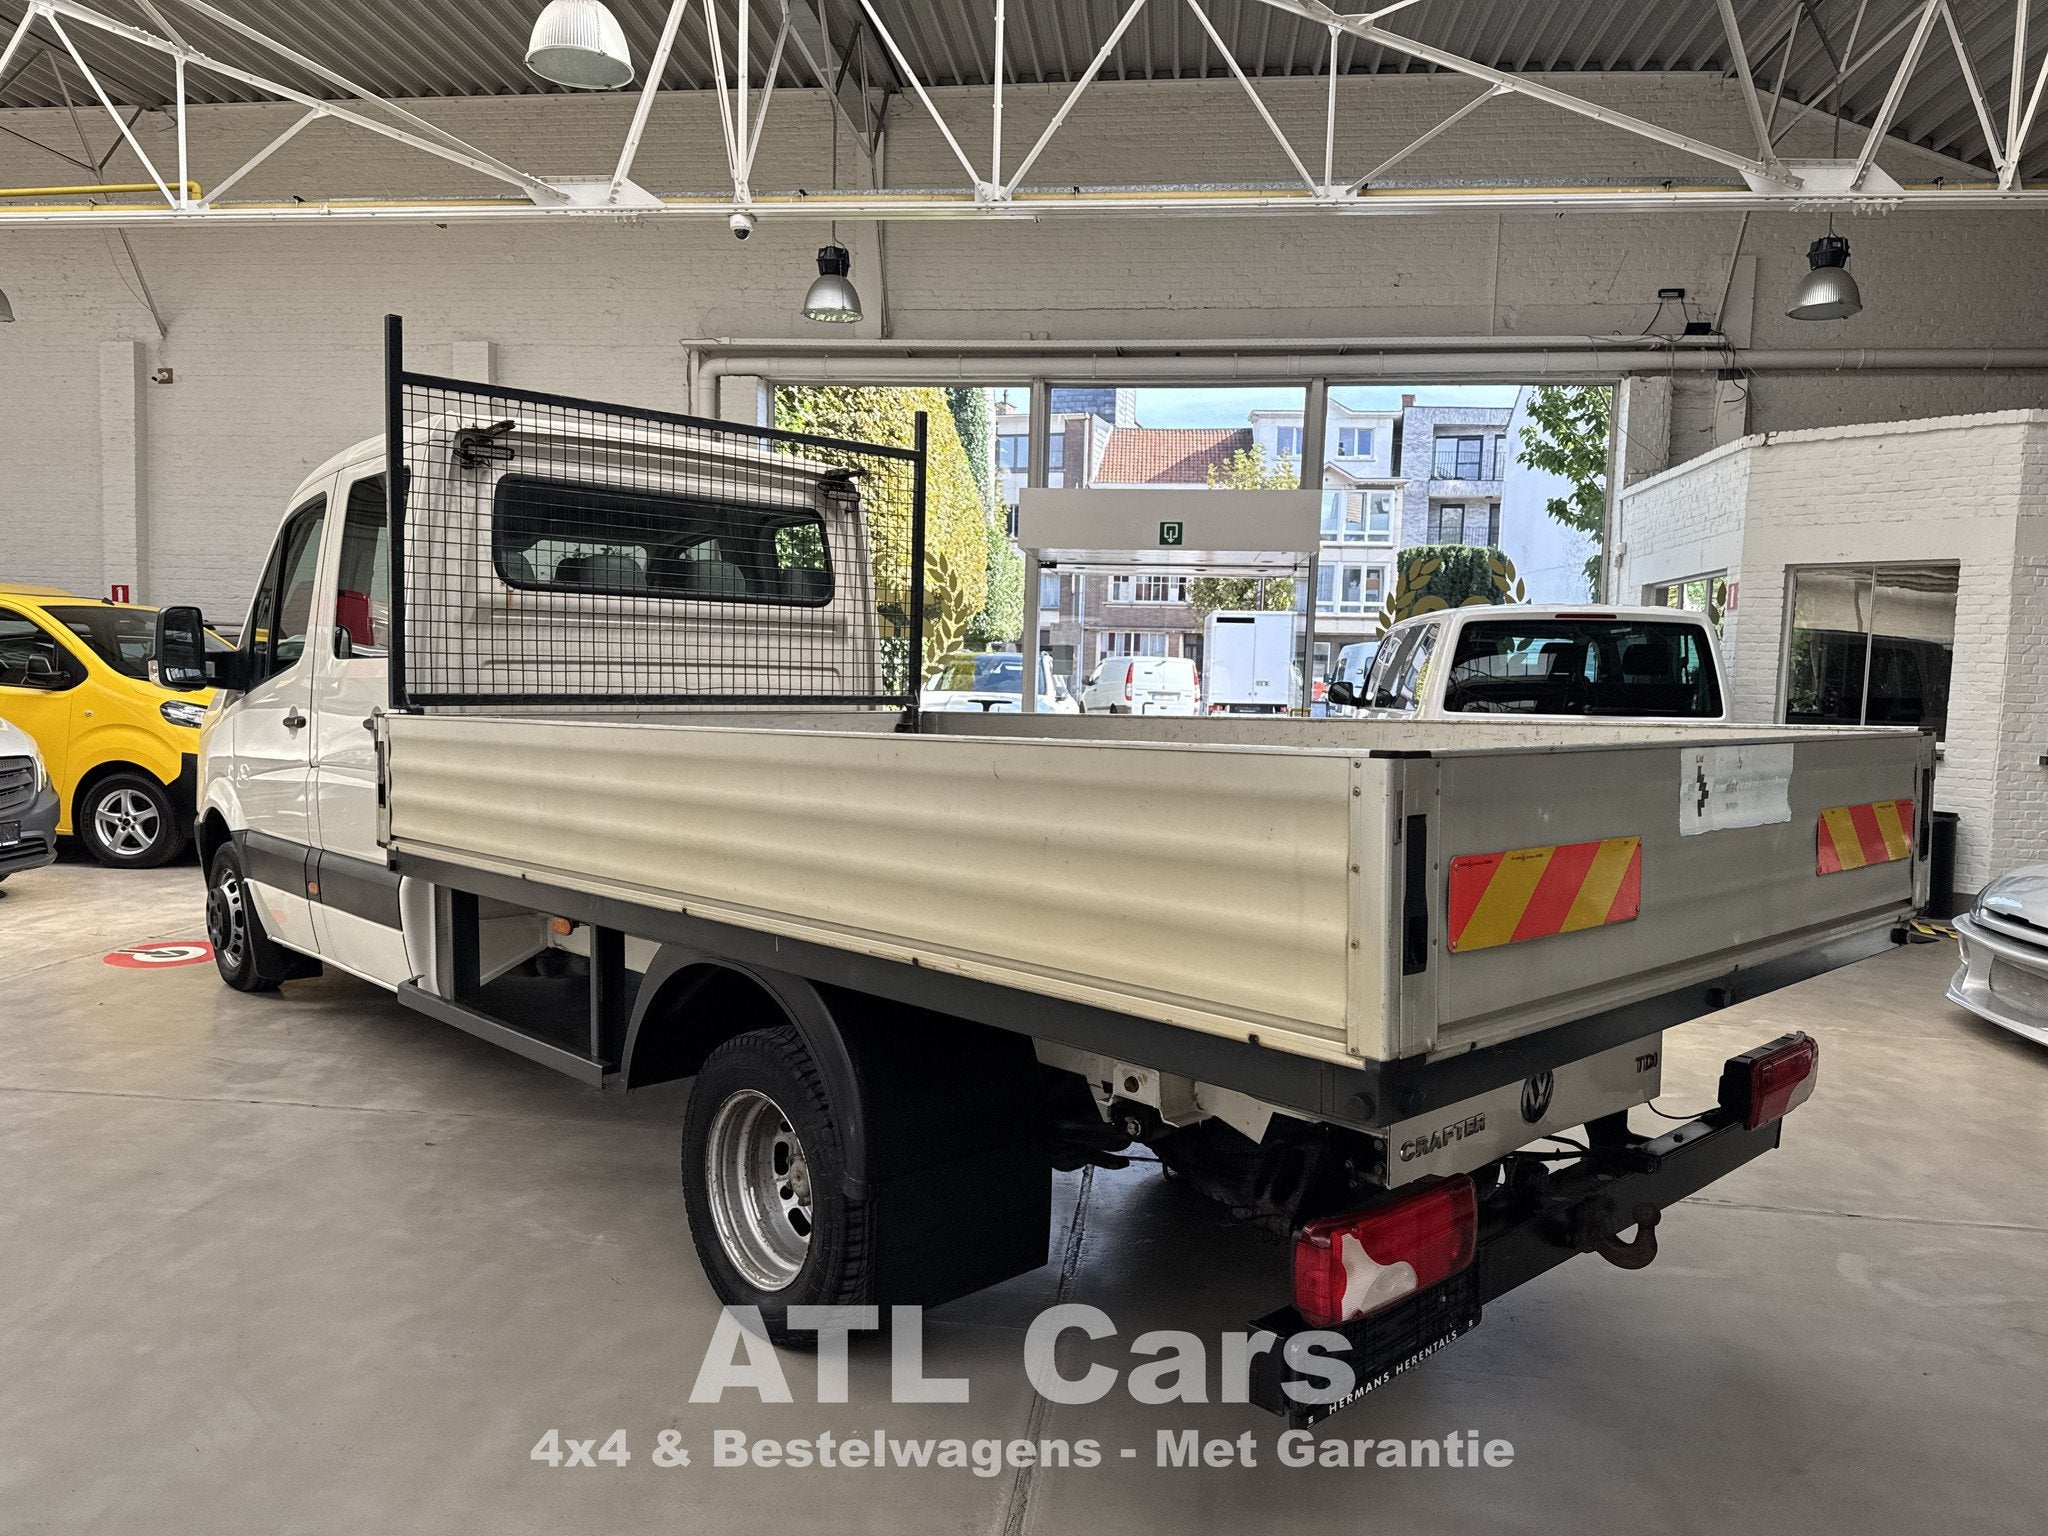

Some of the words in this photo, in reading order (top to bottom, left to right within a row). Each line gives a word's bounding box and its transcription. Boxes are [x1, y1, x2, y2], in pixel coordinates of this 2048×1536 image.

[1400, 1112, 1486, 1163] CRAFTER
[1328, 1371, 1390, 1415] HERMANS
[1395, 1329, 1458, 1375] HERENTALS
